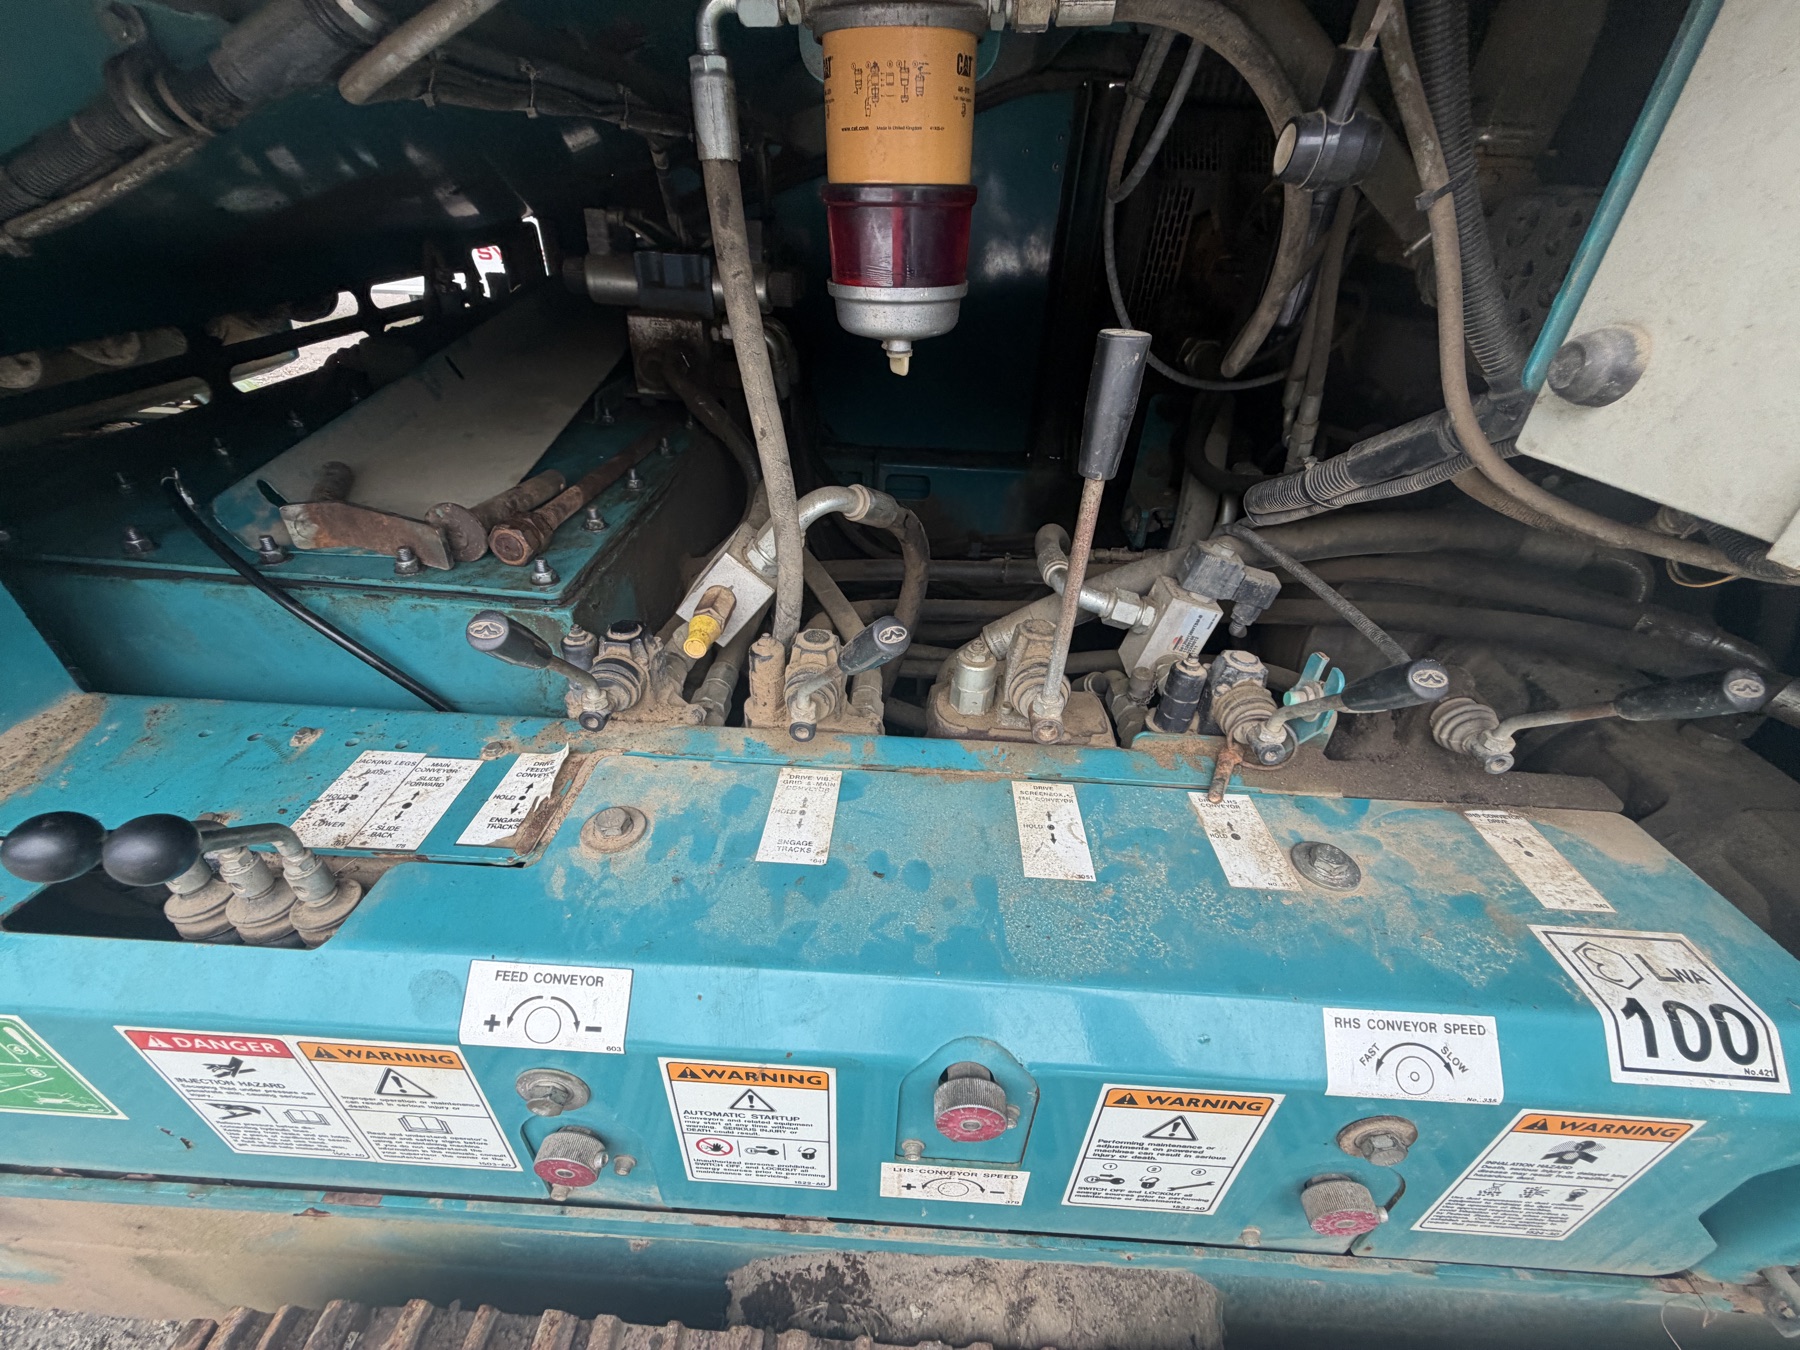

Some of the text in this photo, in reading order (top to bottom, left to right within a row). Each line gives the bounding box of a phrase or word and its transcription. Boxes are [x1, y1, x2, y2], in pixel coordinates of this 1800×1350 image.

[957, 52, 973, 77] CAT
[312, 820, 345, 828] LOWER
[370, 831, 395, 839] BACK
[777, 839, 814, 847] ENGAGE
[494, 970, 604, 987] FEED CONVEYOR
[1334, 1017, 1486, 1036] RHS CONVEYOR SPEED
[1620, 997, 1759, 1066] 100
[172, 1037, 279, 1053] DANGER
[338, 1049, 455, 1064] WARNING
[1359, 1042, 1381, 1067] FAST
[1440, 1046, 1470, 1074] SLOW
[701, 1069, 822, 1085] WARNING
[1744, 1067, 1774, 1077] No.421
[174, 1077, 286, 1089] INJECTION HAZARD
[1147, 1095, 1263, 1111] WARNING
[683, 1109, 800, 1121] AUTOMATIC STARTUP
[1560, 1121, 1680, 1137] WARNING
[919, 1169, 978, 1178] CONVEYOR
[982, 1172, 1019, 1180] SPEED
